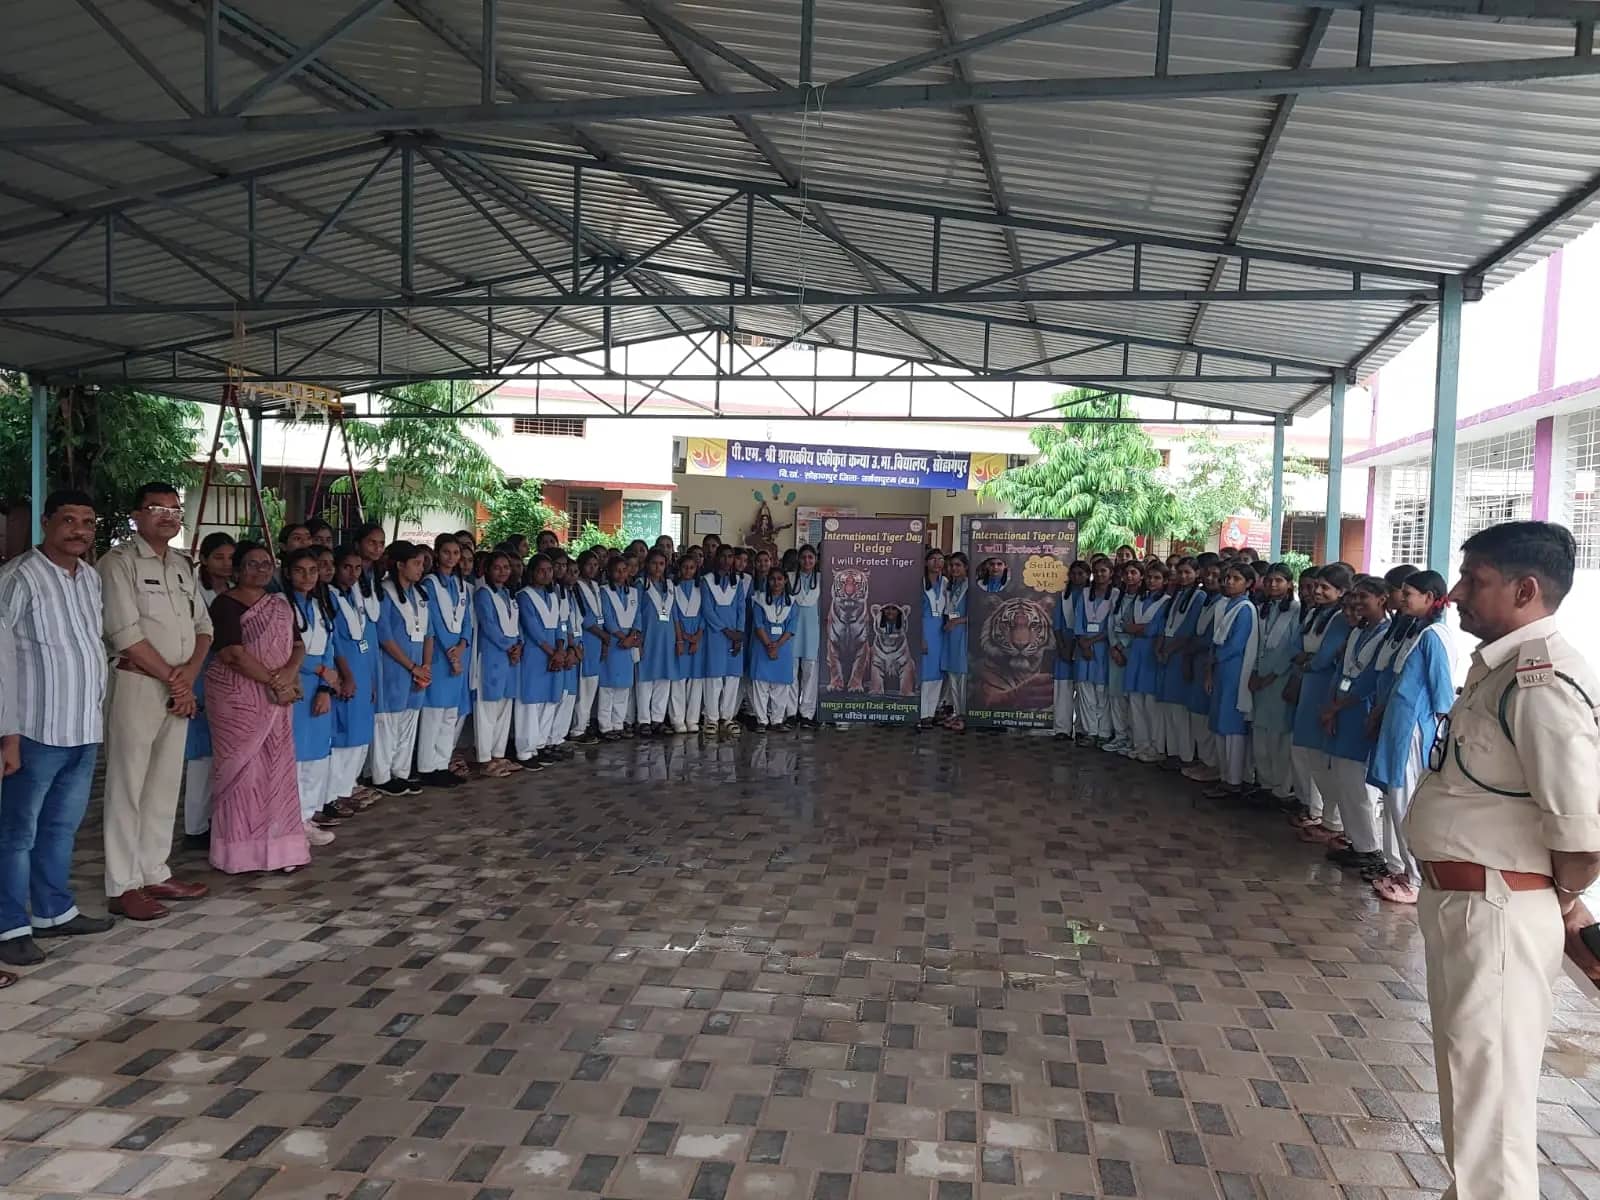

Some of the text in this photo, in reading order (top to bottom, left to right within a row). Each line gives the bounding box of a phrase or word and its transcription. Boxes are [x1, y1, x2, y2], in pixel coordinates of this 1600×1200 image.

[731, 442, 762, 462] पी.एम.
[765, 445, 776, 464] श्री
[778, 447, 814, 466] शासकीय
[816, 449, 847, 472] एकीकृत
[848, 454, 870, 469] कन्या
[932, 455, 969, 478] सोहागपुर
[824, 531, 880, 541] International
[881, 532, 904, 543] Tiger
[905, 532, 923, 543] Day
[972, 530, 1075, 543] International Tiger Day
[853, 543, 892, 555] Pledge
[977, 543, 983, 553] I
[983, 543, 1003, 553] will
[1005, 544, 1041, 554] Protect
[837, 557, 854, 565] will
[855, 557, 889, 566] Protect
[891, 557, 914, 568] Tiger
[1029, 561, 1061, 569] Selfie
[1032, 571, 1059, 579] with
